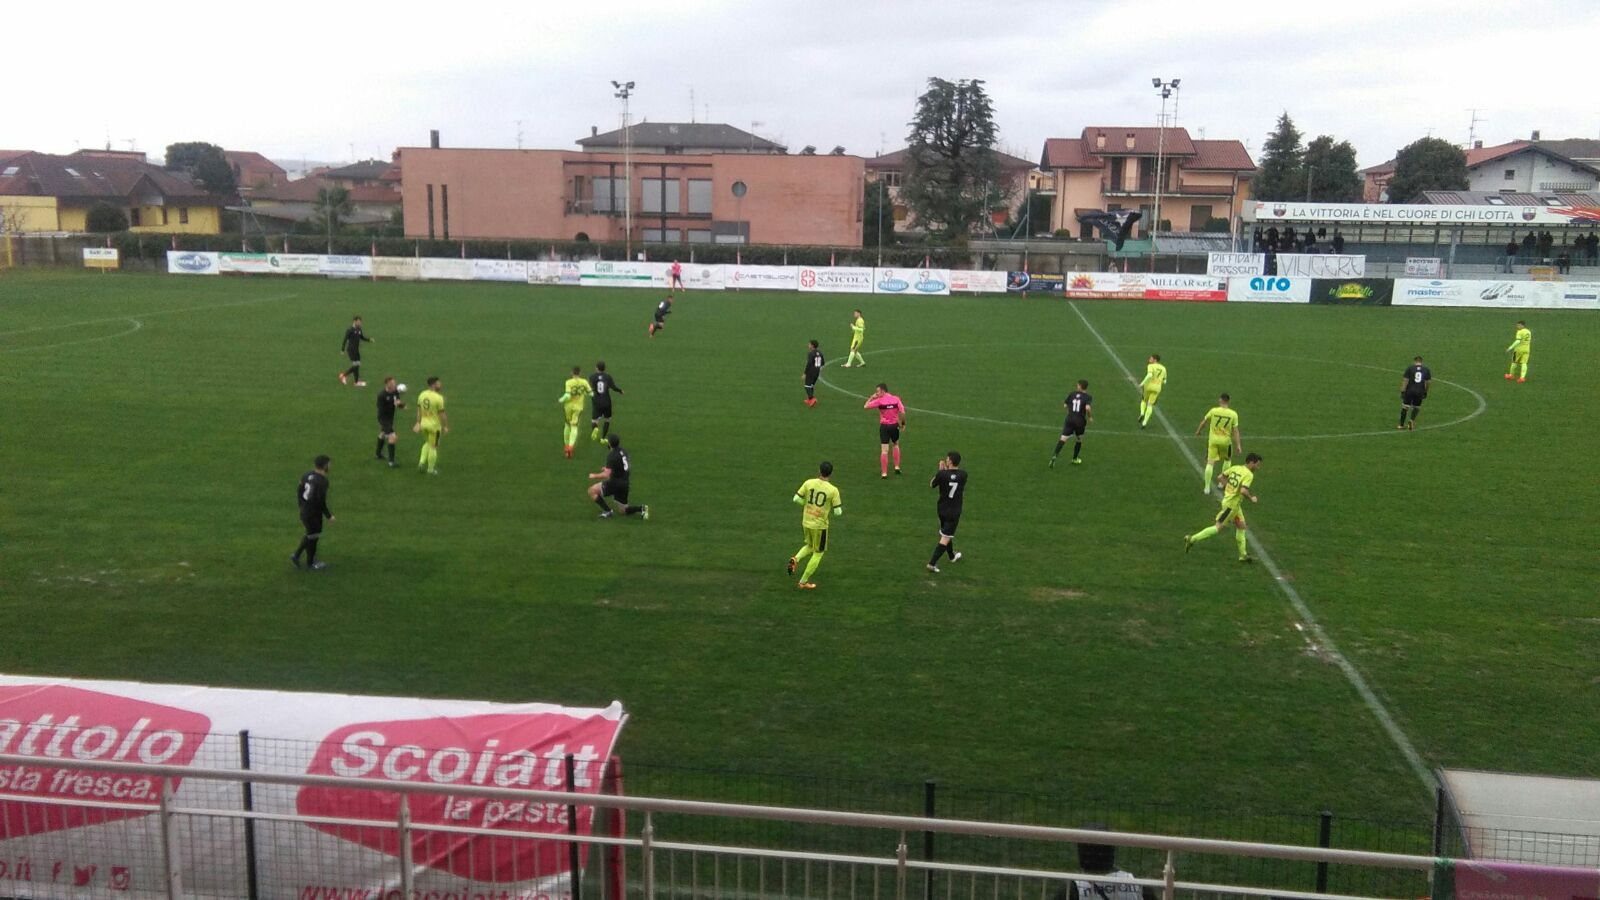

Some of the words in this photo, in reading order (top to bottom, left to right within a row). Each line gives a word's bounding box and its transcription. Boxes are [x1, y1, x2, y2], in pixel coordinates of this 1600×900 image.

[1293, 208, 1306, 217] LA
[1310, 208, 1360, 218] VITTORIA
[1363, 206, 1370, 218] È
[1373, 209, 1394, 219] NEL
[1397, 209, 1438, 219] CUORE
[1440, 210, 1452, 219] DI
[1455, 210, 1476, 220] CHI
[1478, 210, 1515, 220] LOTTA
[1280, 255, 1363, 277] VINCERE
[1150, 278, 1195, 287] MILLCAR
[1250, 277, 1291, 292] aro
[1414, 371, 1422, 383] 9
[1072, 399, 1081, 412] 11
[1214, 414, 1231, 428] 77
[948, 482, 959, 498] 7
[808, 488, 827, 507] 10
